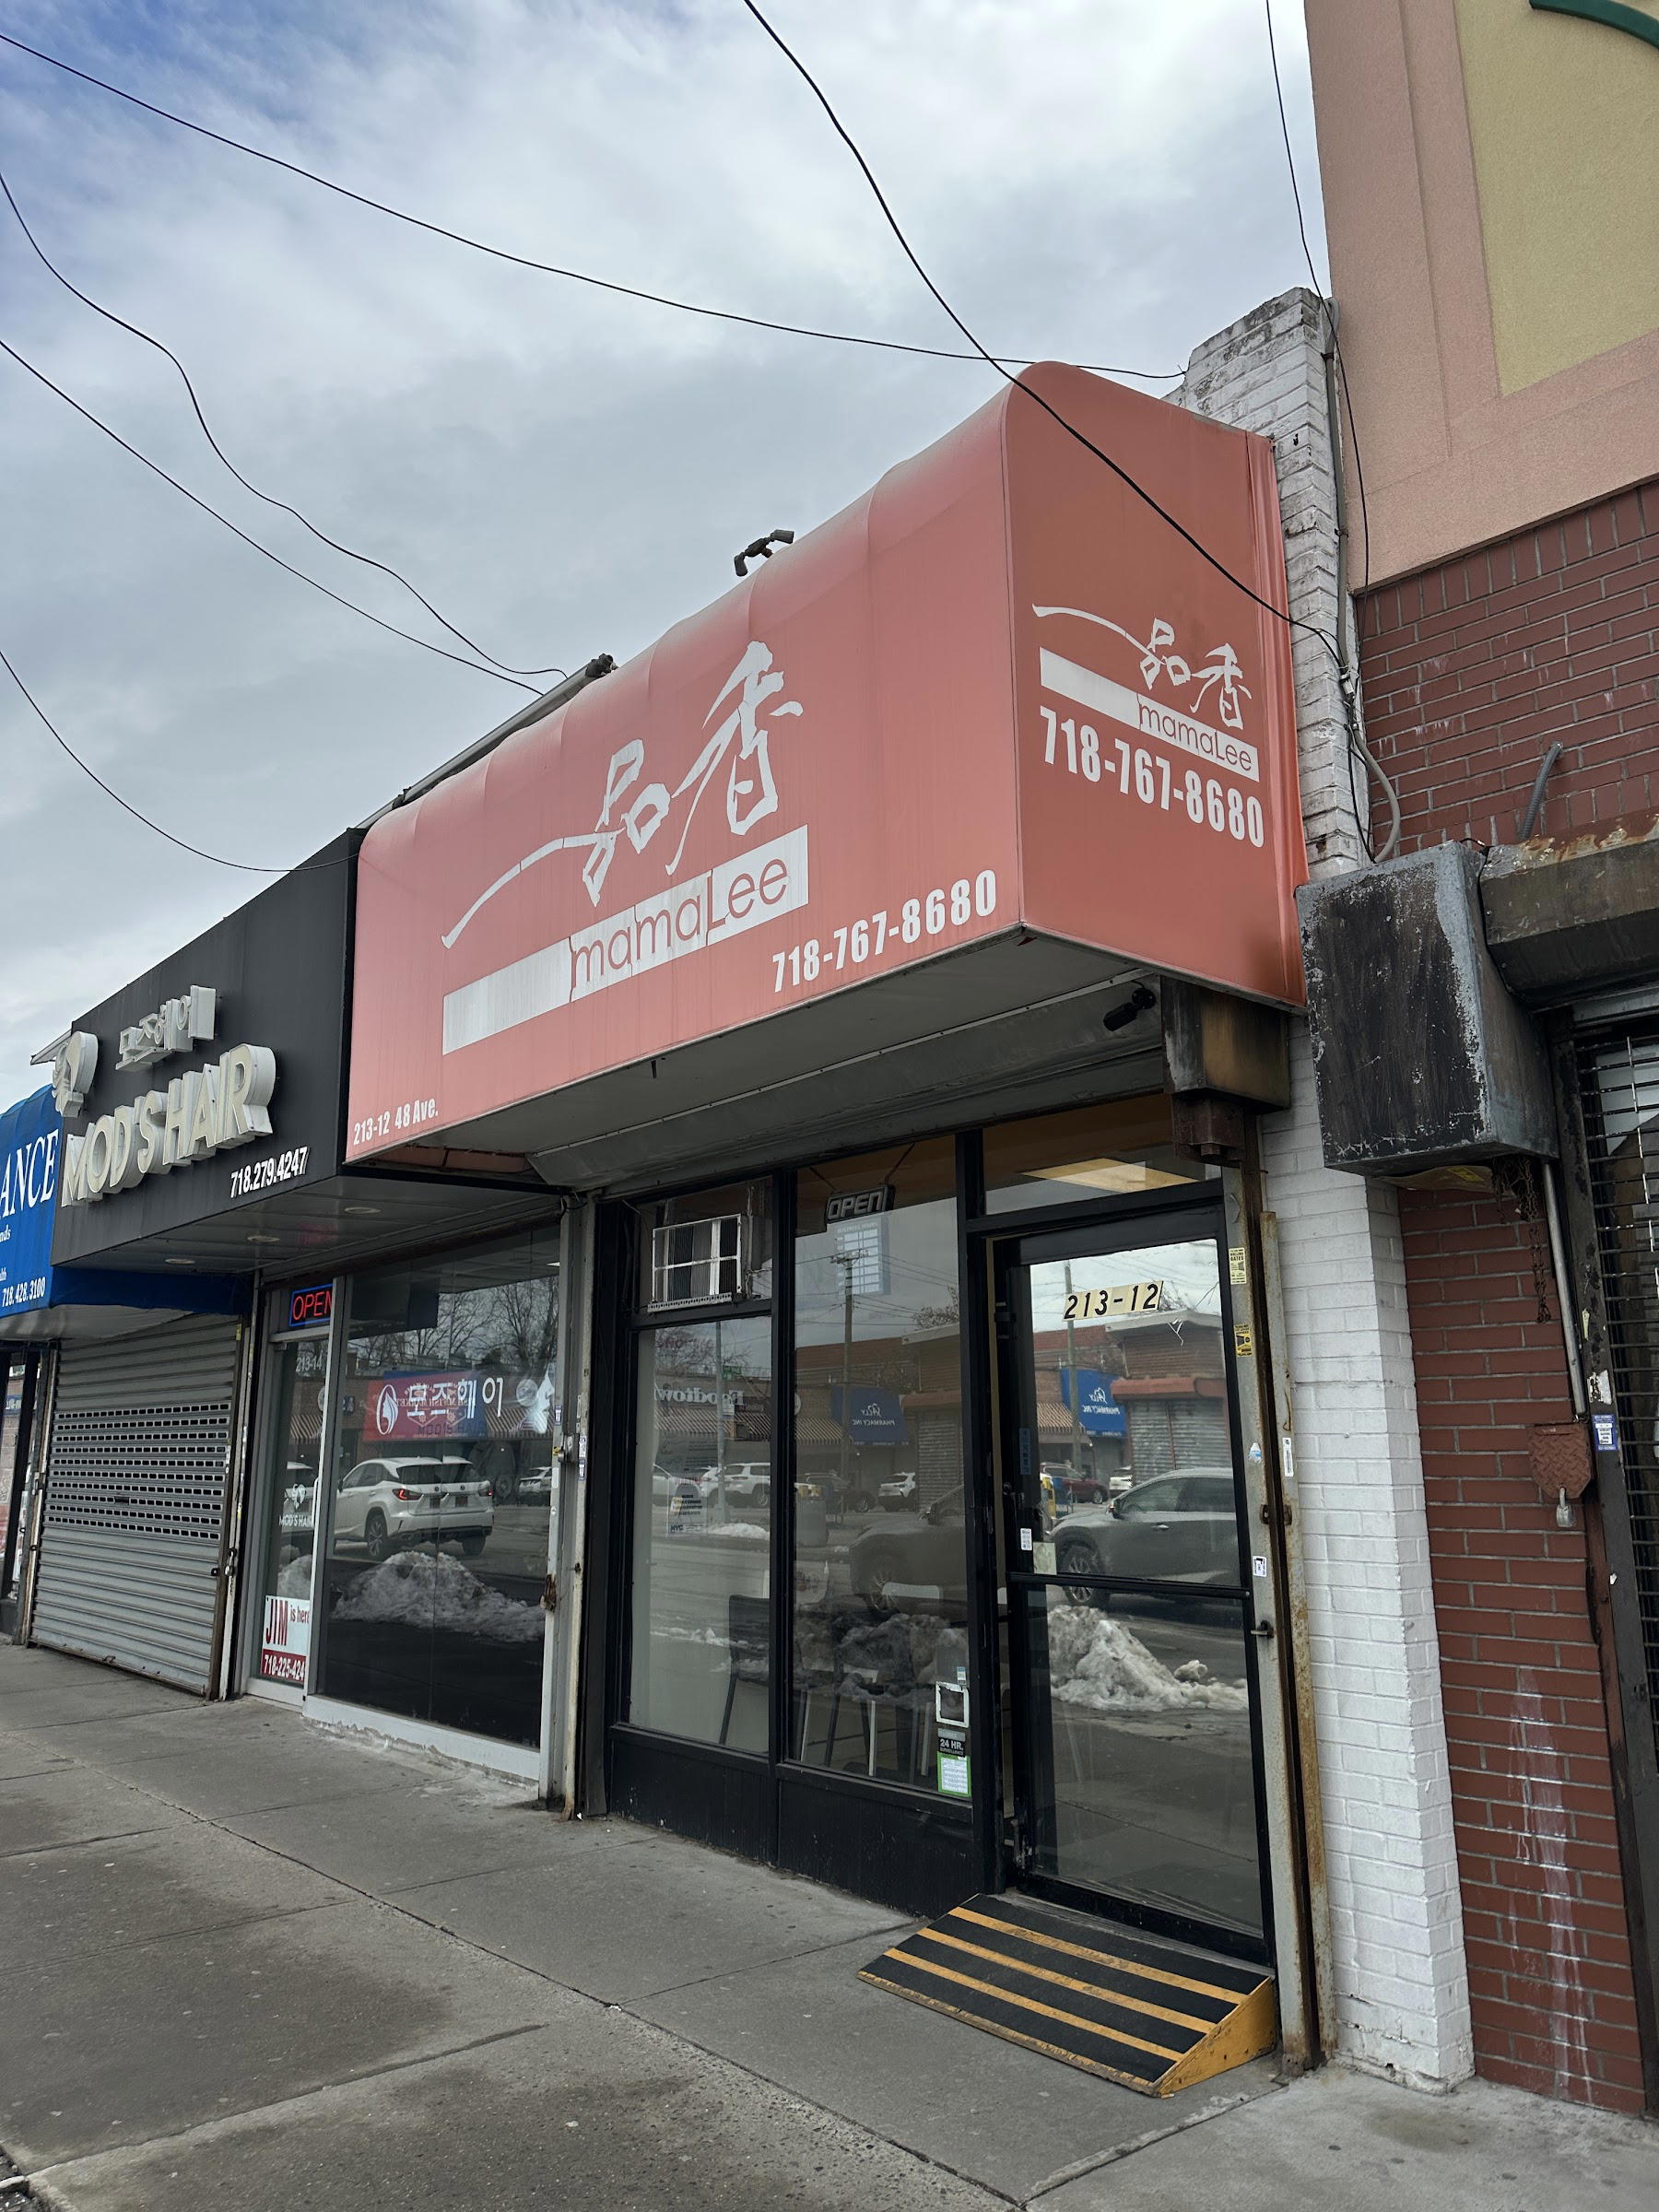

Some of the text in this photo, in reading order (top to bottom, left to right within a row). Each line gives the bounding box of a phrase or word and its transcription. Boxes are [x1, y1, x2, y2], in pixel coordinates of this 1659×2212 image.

[1139, 702, 1253, 771] mamaLee
[1040, 705, 1265, 848] 718-767-8680
[571, 858, 788, 989] mamaLee
[771, 869, 998, 994] 718-767-8680
[162, 1043, 276, 1167] HAIR
[353, 1098, 439, 1147] 213-12 48 Ave.
[229, 1146, 310, 1198] 718.279.4247
[2, 1277, 46, 1308] 718.428.3100
[1065, 1282, 1159, 1320] 213-12
[265, 1598, 288, 1646] JIM
[940, 1738, 950, 1748] 24
